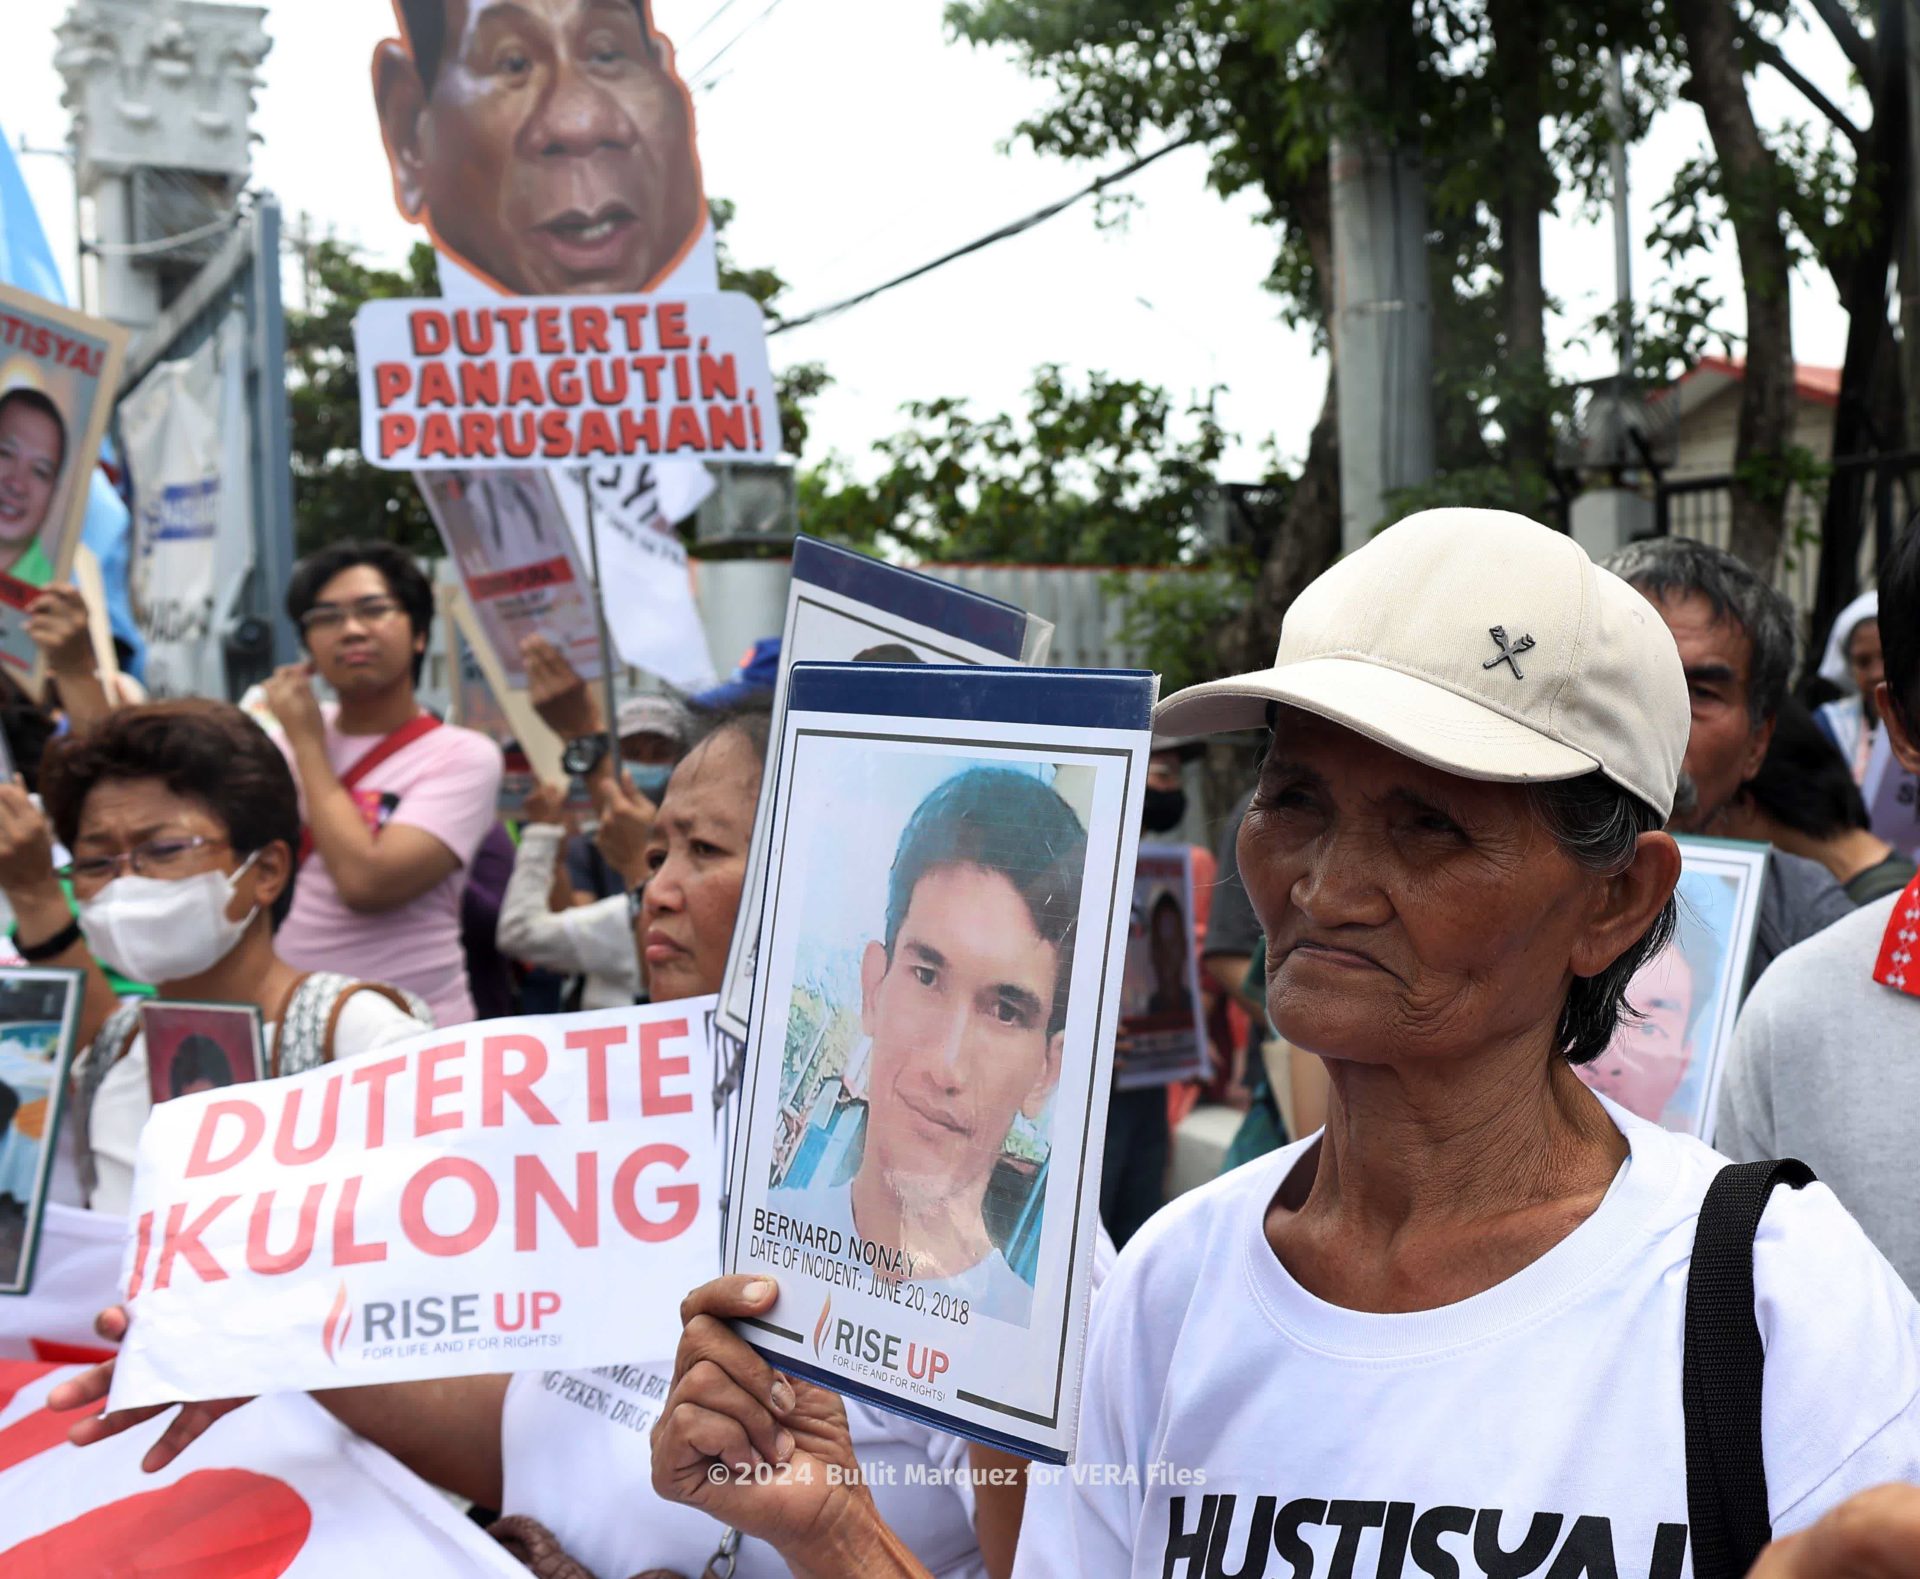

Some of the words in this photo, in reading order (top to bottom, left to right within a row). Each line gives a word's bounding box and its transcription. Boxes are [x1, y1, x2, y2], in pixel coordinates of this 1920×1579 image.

[0, 313, 105, 378] TISYA!
[410, 303, 708, 356] DUTERTE,
[375, 352, 755, 408] PANAGUTIN,
[378, 403, 764, 460] PARUSAHAN!
[184, 1018, 693, 1179] DUTERTE
[127, 1143, 700, 1301] IKULONG
[753, 1208, 842, 1255] BERNARD
[848, 1236, 919, 1278] NONAY
[750, 1235, 781, 1265] DATE
[782, 1246, 800, 1267] OF
[801, 1250, 862, 1292] INCIDENT:
[868, 1276, 902, 1304] JUNE
[905, 1284, 927, 1317] 20,
[931, 1291, 970, 1325] 2018
[363, 1294, 480, 1342] RISE
[494, 1292, 561, 1332] UP
[362, 1347, 392, 1360] FOR
[397, 1342, 428, 1357] LIFE
[433, 1340, 463, 1354] AND
[469, 1336, 498, 1349] FOR
[503, 1334, 562, 1348] RIGHTS!
[835, 1318, 902, 1371] RISE
[907, 1342, 950, 1384] UP
[833, 1354, 849, 1369] FOR
[851, 1360, 868, 1376] LIFE
[870, 1367, 888, 1382] AND
[890, 1374, 907, 1390] FOR
[910, 1381, 946, 1403] RIGHTS!
[610, 1399, 650, 1432] DRUG
